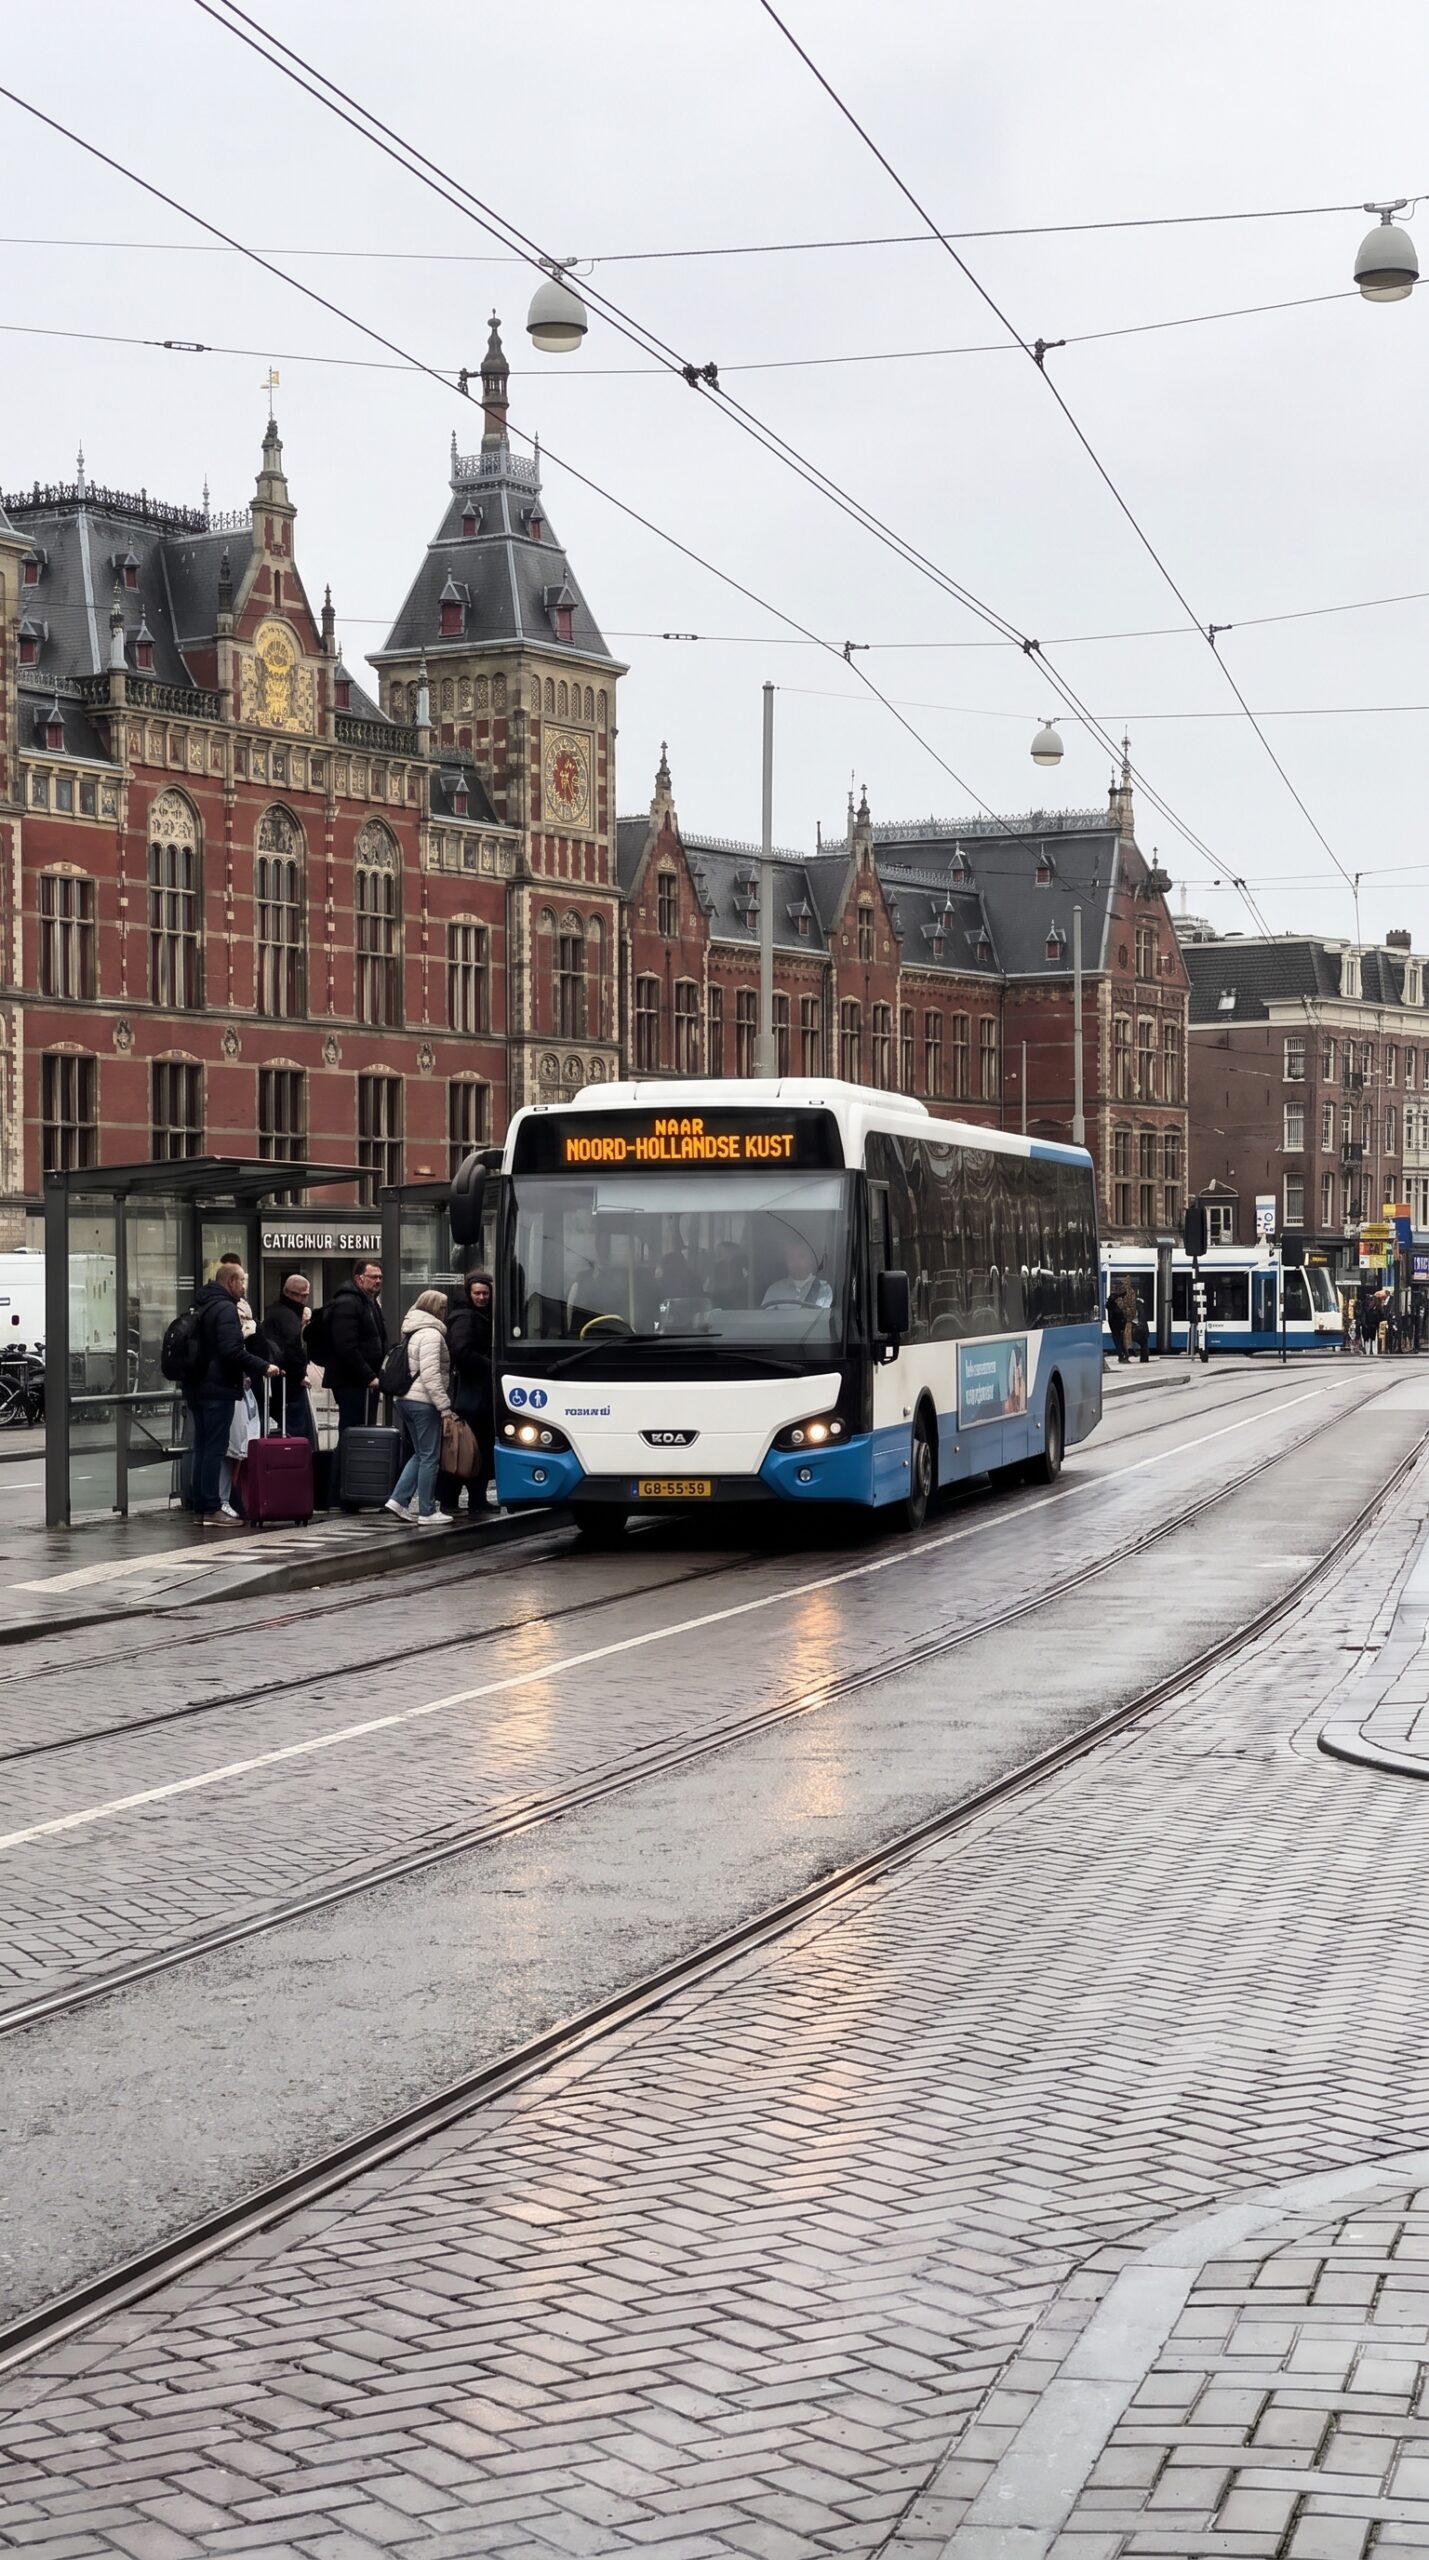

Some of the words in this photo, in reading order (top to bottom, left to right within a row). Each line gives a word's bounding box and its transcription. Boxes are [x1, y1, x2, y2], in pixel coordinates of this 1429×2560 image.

[655, 1118, 704, 1135] NAAR
[566, 1135, 740, 1160] NOORD-HOLLANDSE
[745, 1135, 794, 1157] KUST
